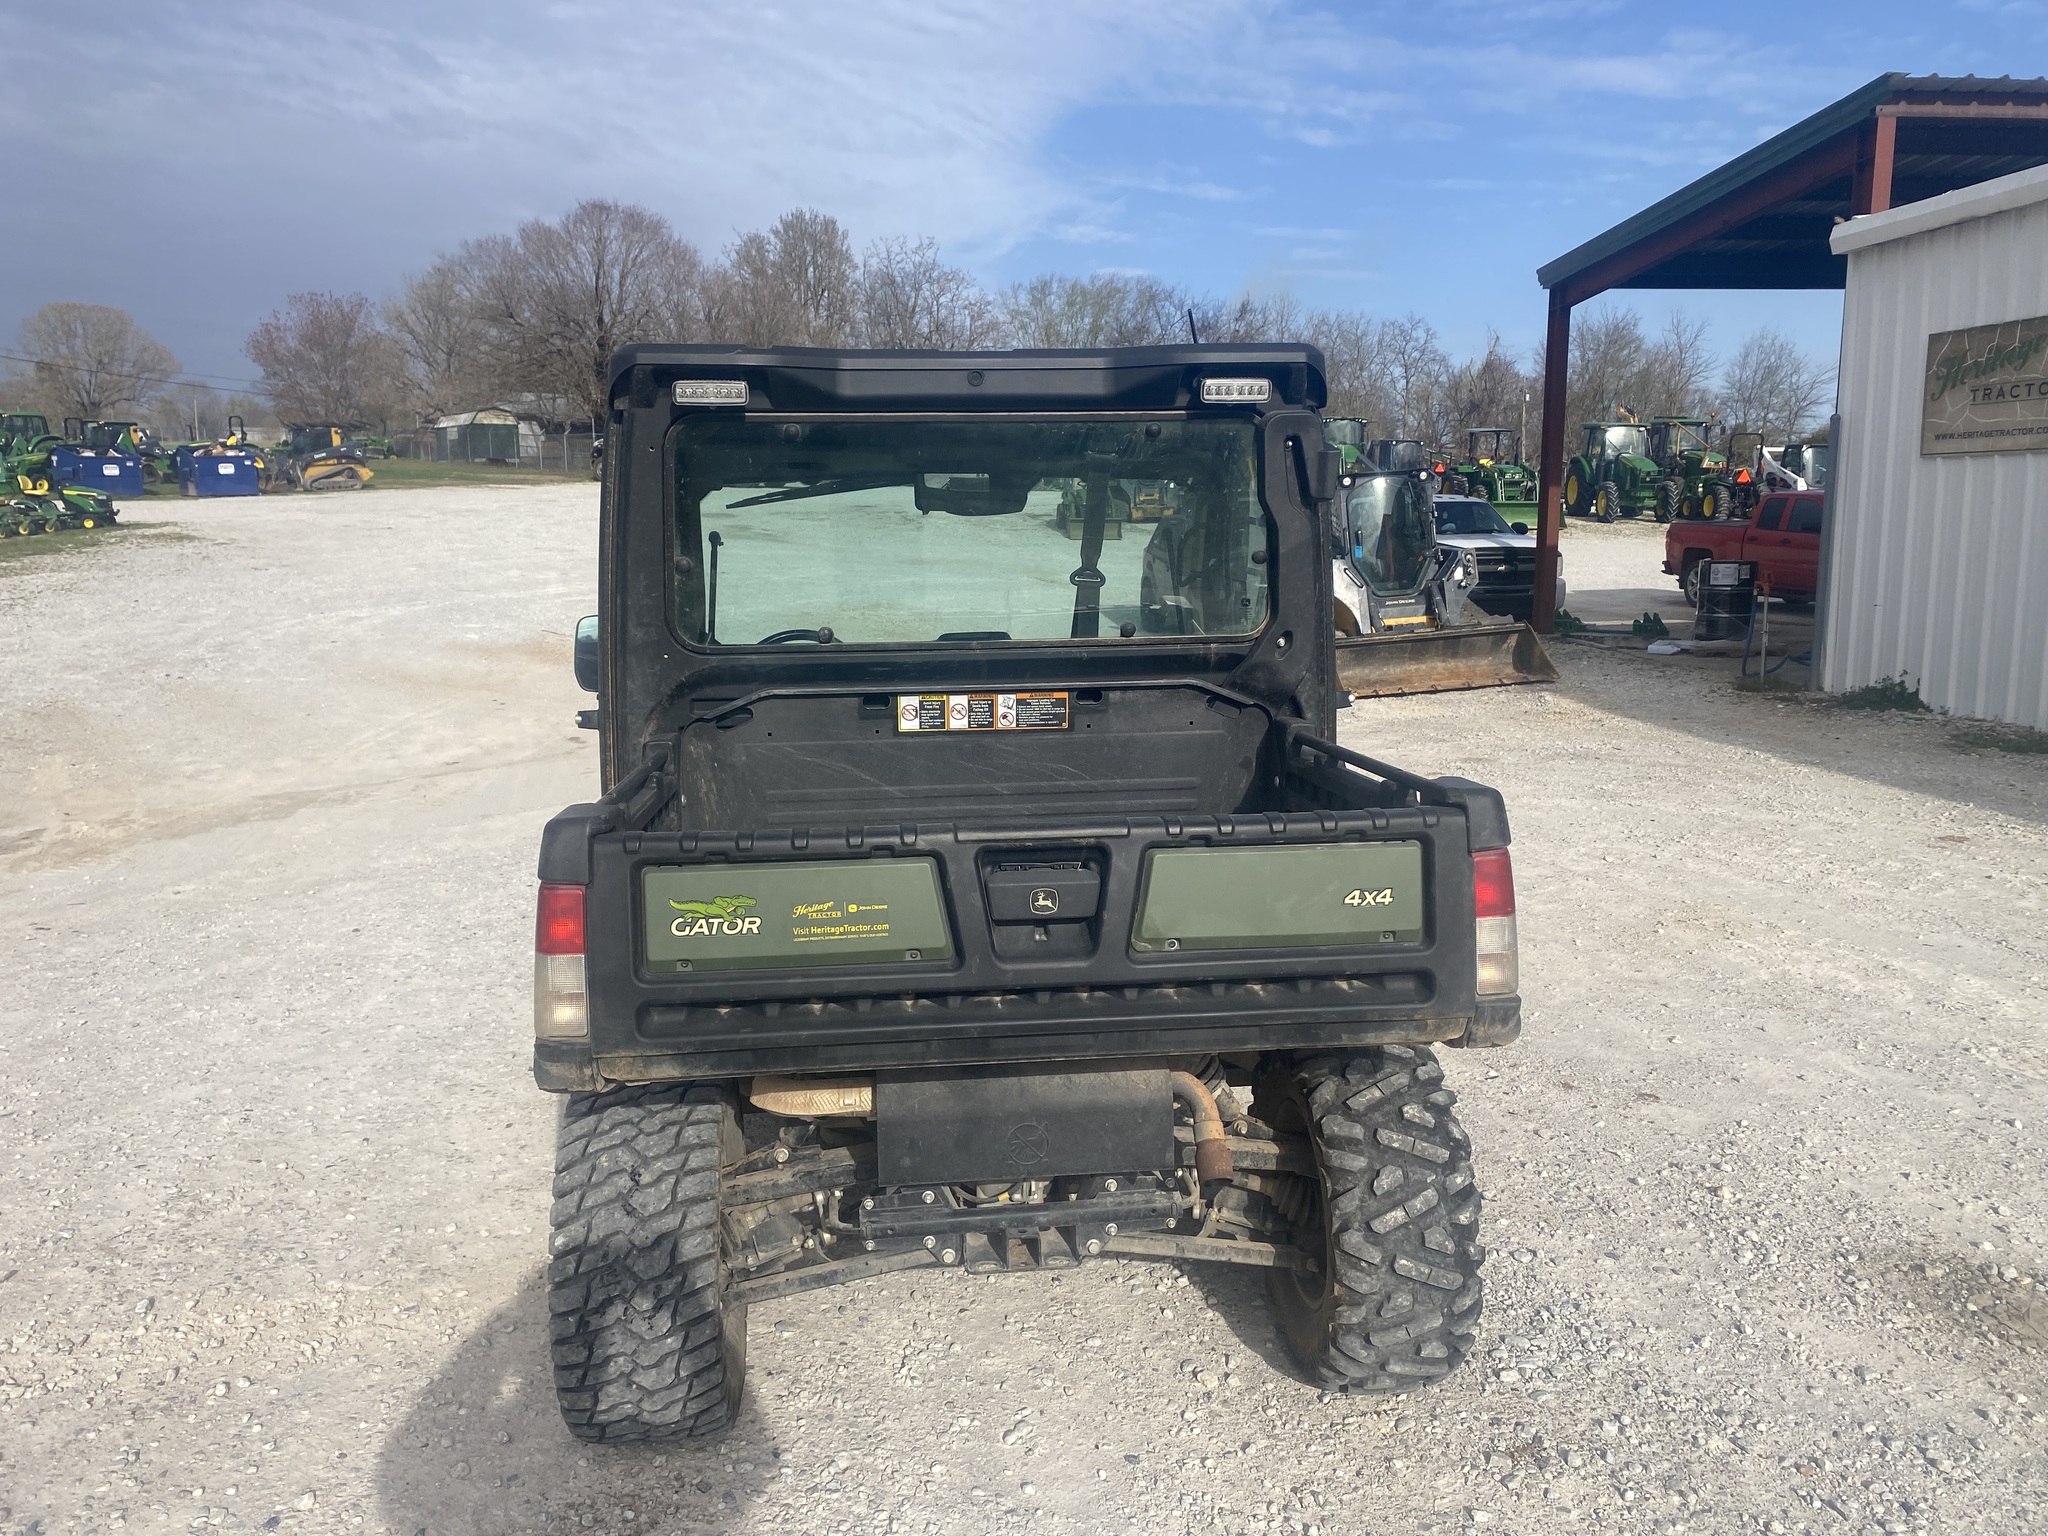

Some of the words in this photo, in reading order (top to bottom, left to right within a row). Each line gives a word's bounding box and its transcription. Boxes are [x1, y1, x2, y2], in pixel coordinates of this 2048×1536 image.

[1343, 887, 1395, 907] 4x4
[792, 901, 835, 918] Heritage
[670, 917, 762, 937] GATOR
[792, 927, 810, 935] Visit
[811, 924, 889, 934] HeritageTractor.com
